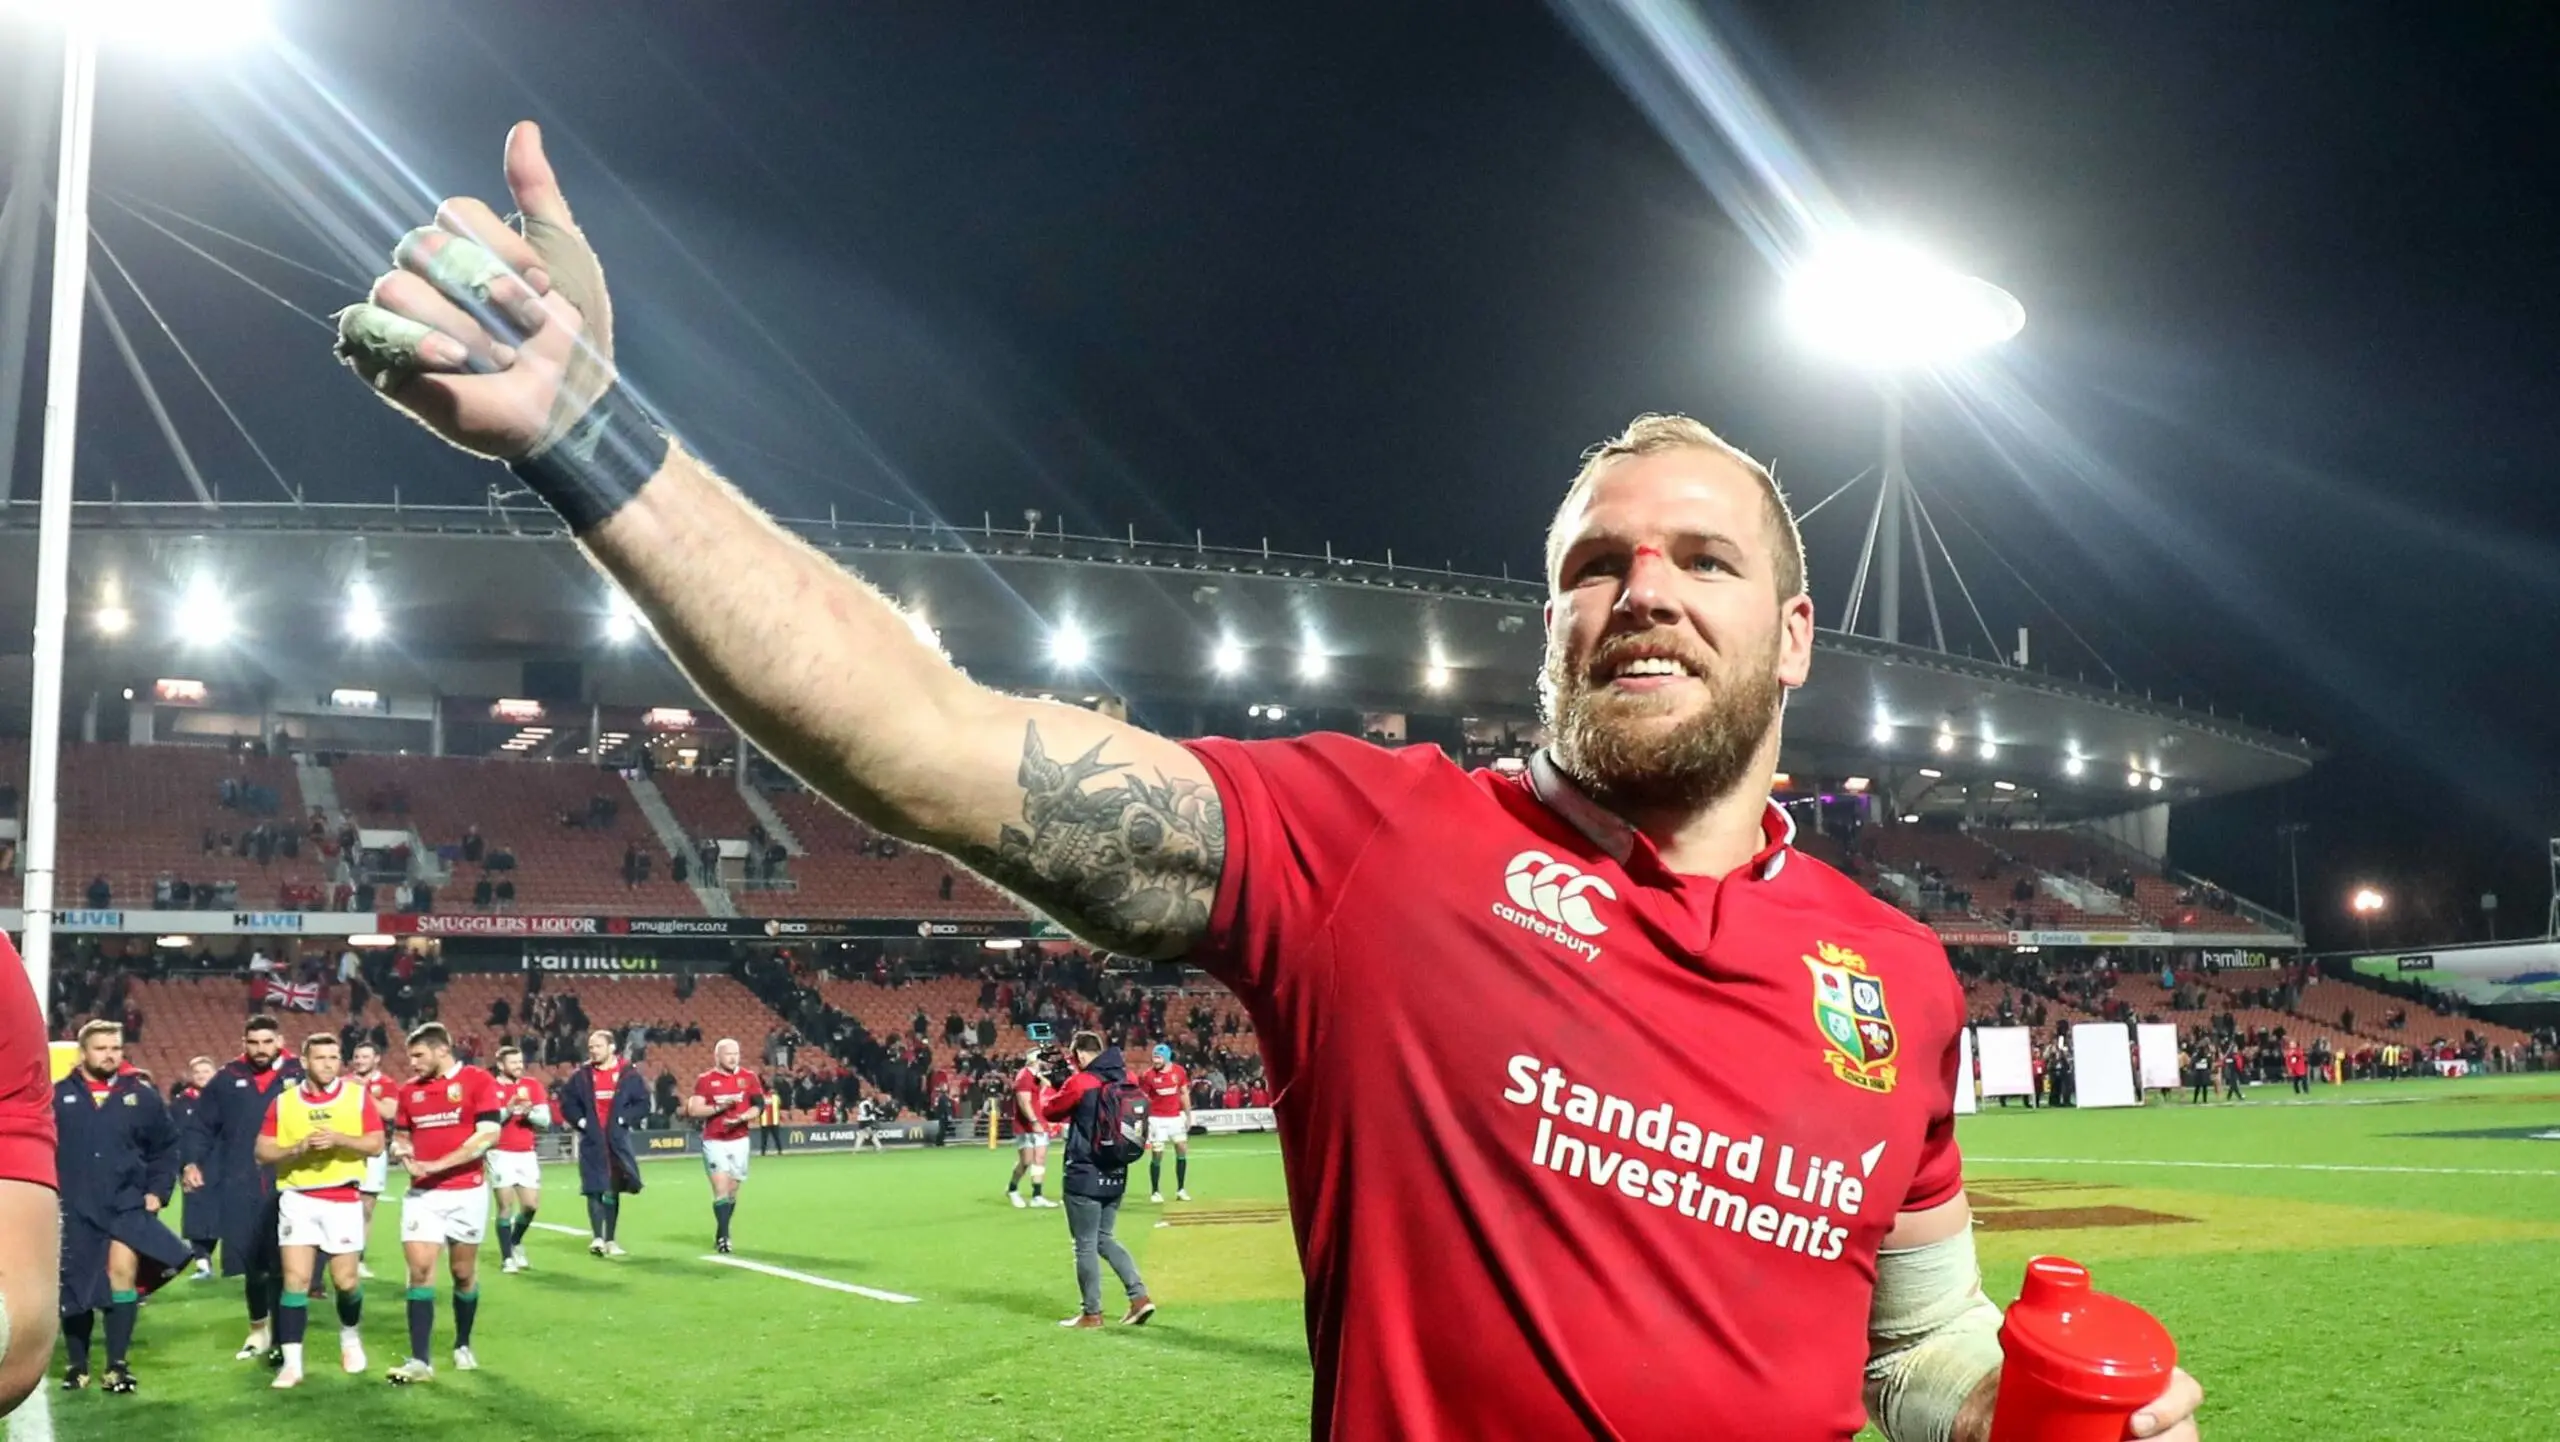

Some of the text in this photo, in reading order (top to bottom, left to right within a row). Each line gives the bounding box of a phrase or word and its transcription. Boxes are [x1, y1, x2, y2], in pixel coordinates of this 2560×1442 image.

[415, 915, 596, 934] SMUGGLERS LIQUOR
[629, 919, 728, 936] smugglers.co.nz
[1490, 900, 1602, 963] canterbury
[2202, 948, 2266, 968] hamilton
[649, 1136, 685, 1148] ASB
[810, 1131, 828, 1141] ALL
[830, 1130, 854, 1140] FANS
[1503, 1053, 1864, 1216] Standard Life
[1530, 1117, 1850, 1262] Investments
